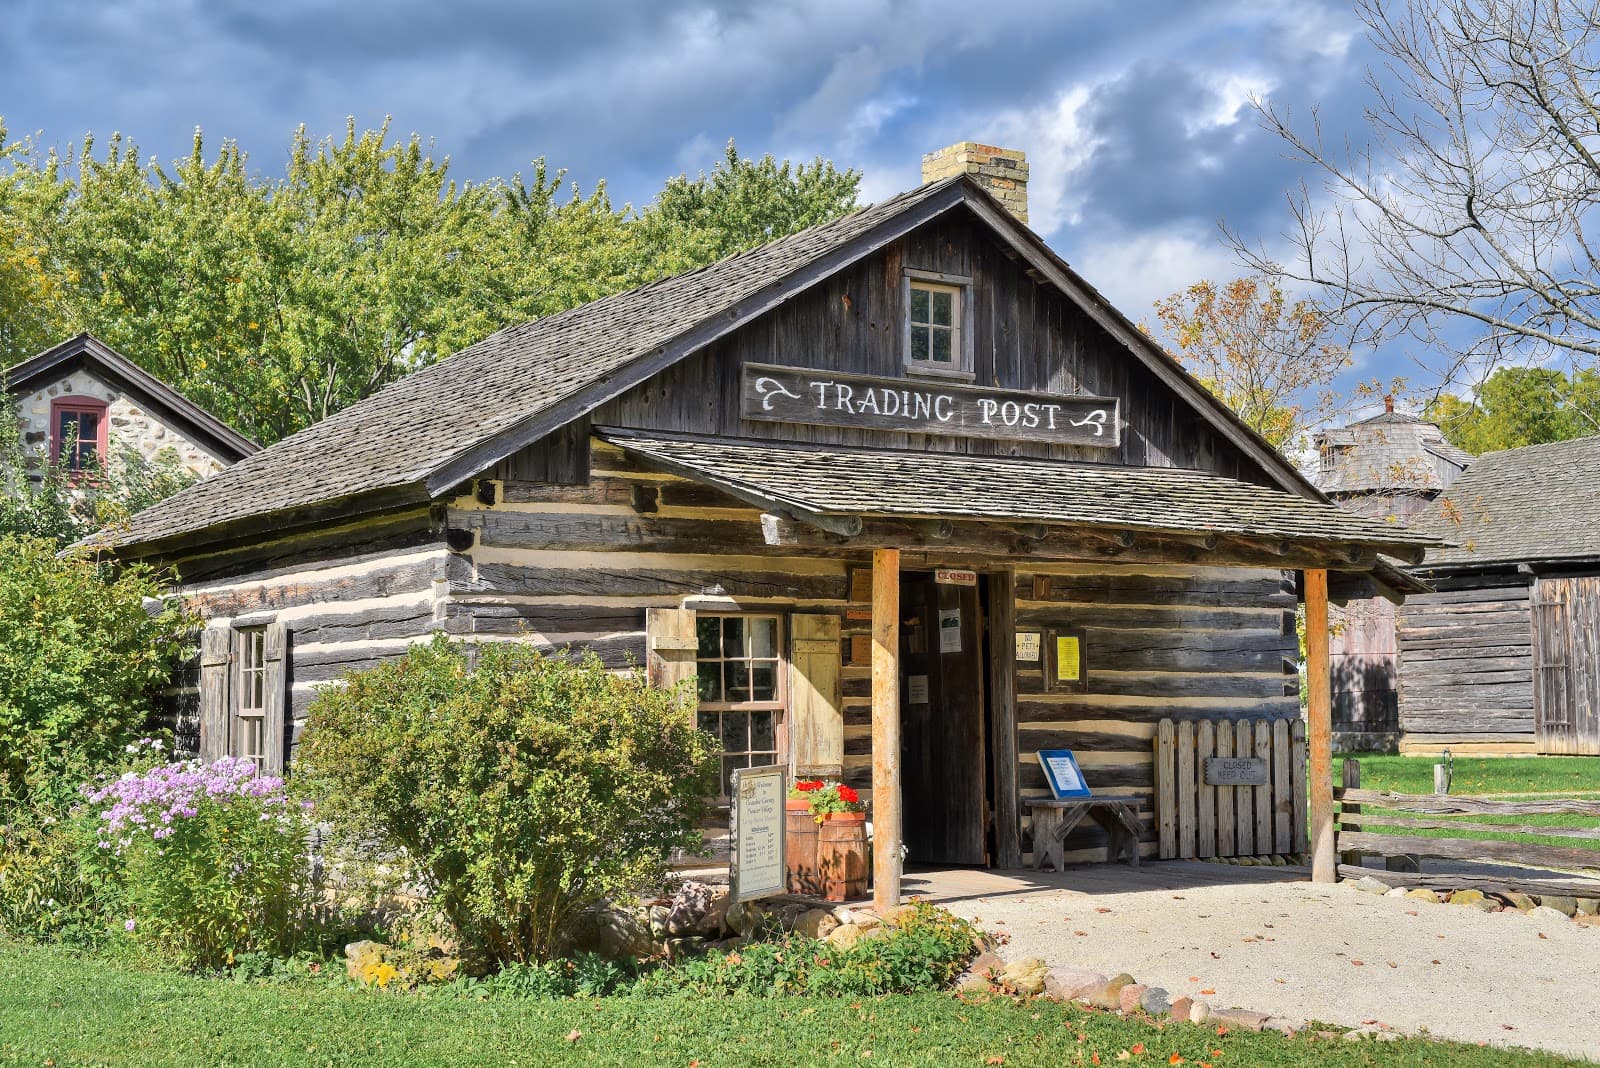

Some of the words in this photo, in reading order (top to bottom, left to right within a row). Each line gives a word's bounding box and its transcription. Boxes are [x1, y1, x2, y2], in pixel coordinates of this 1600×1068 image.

[810, 380, 953, 422] TRADING
[977, 398, 1061, 429] POST
[937, 571, 975, 581] CLOSED
[1024, 634, 1033, 642] NO
[1223, 761, 1252, 770] CLOSED
[1218, 770, 1236, 780] KEEP
[1239, 770, 1257, 780] OUT
